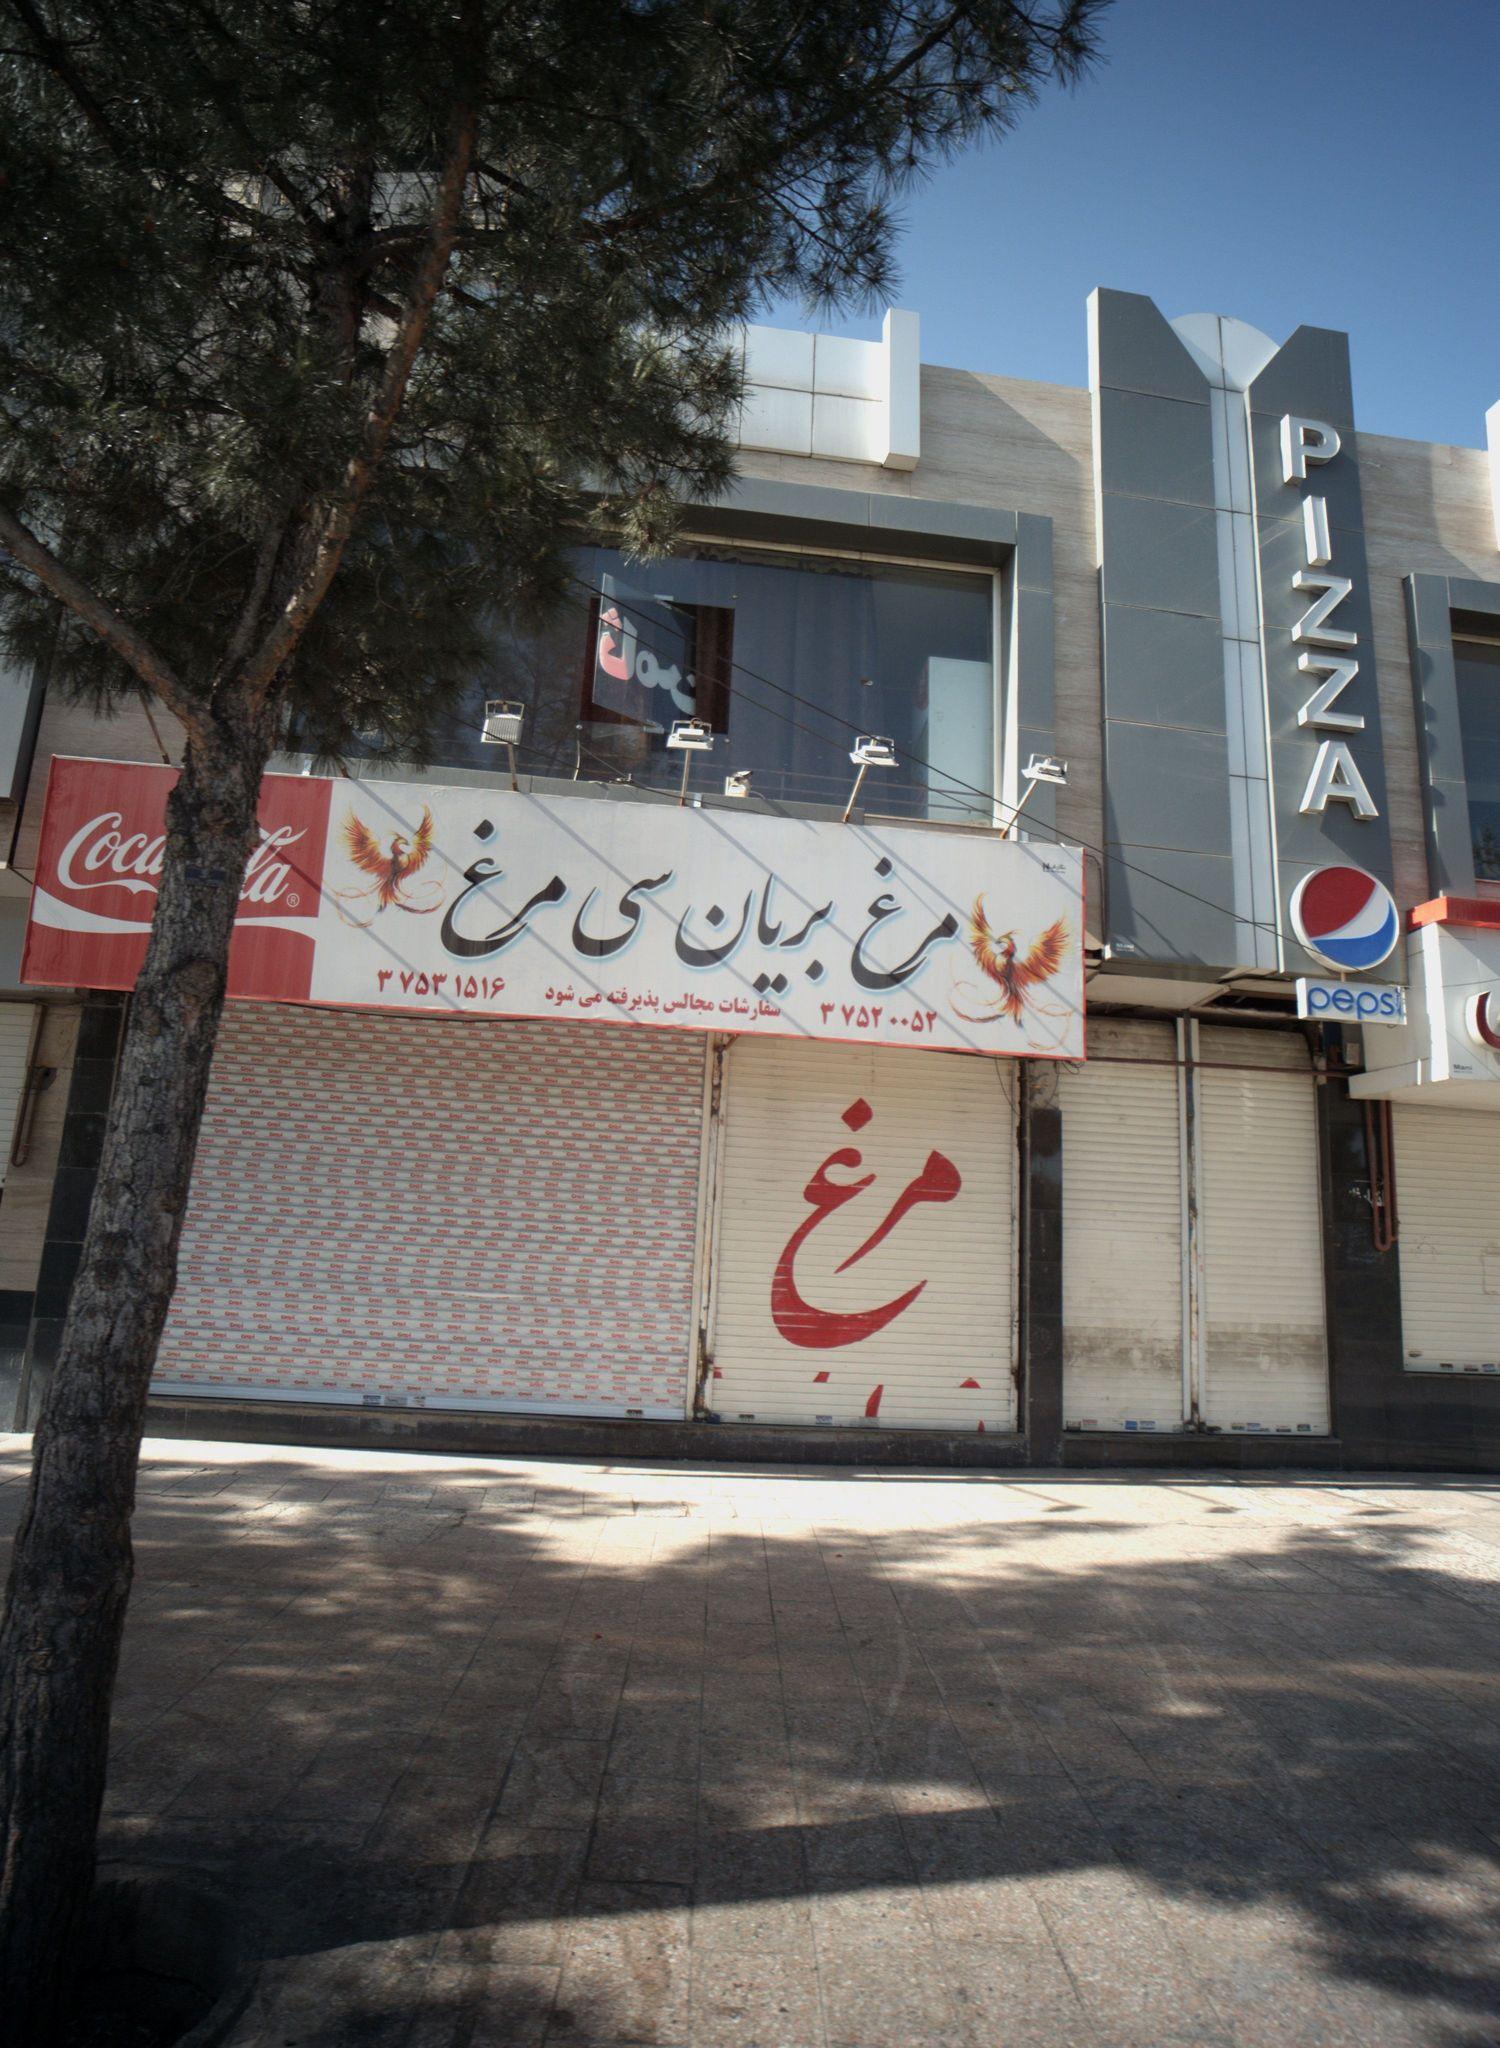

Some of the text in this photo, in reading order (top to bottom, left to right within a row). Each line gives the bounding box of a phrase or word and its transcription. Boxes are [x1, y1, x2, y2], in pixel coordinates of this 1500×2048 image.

[1280, 413, 1379, 821] PIZZA
[57, 811, 308, 903] Cocala
[675, 872, 834, 993] بریان
[851, 857, 959, 990] مرغ
[606, 987, 659, 1013] پذیرفته
[663, 993, 714, 1015] مجالس
[719, 997, 781, 1020] سفارشات
[771, 1097, 961, 1349] مرغ
